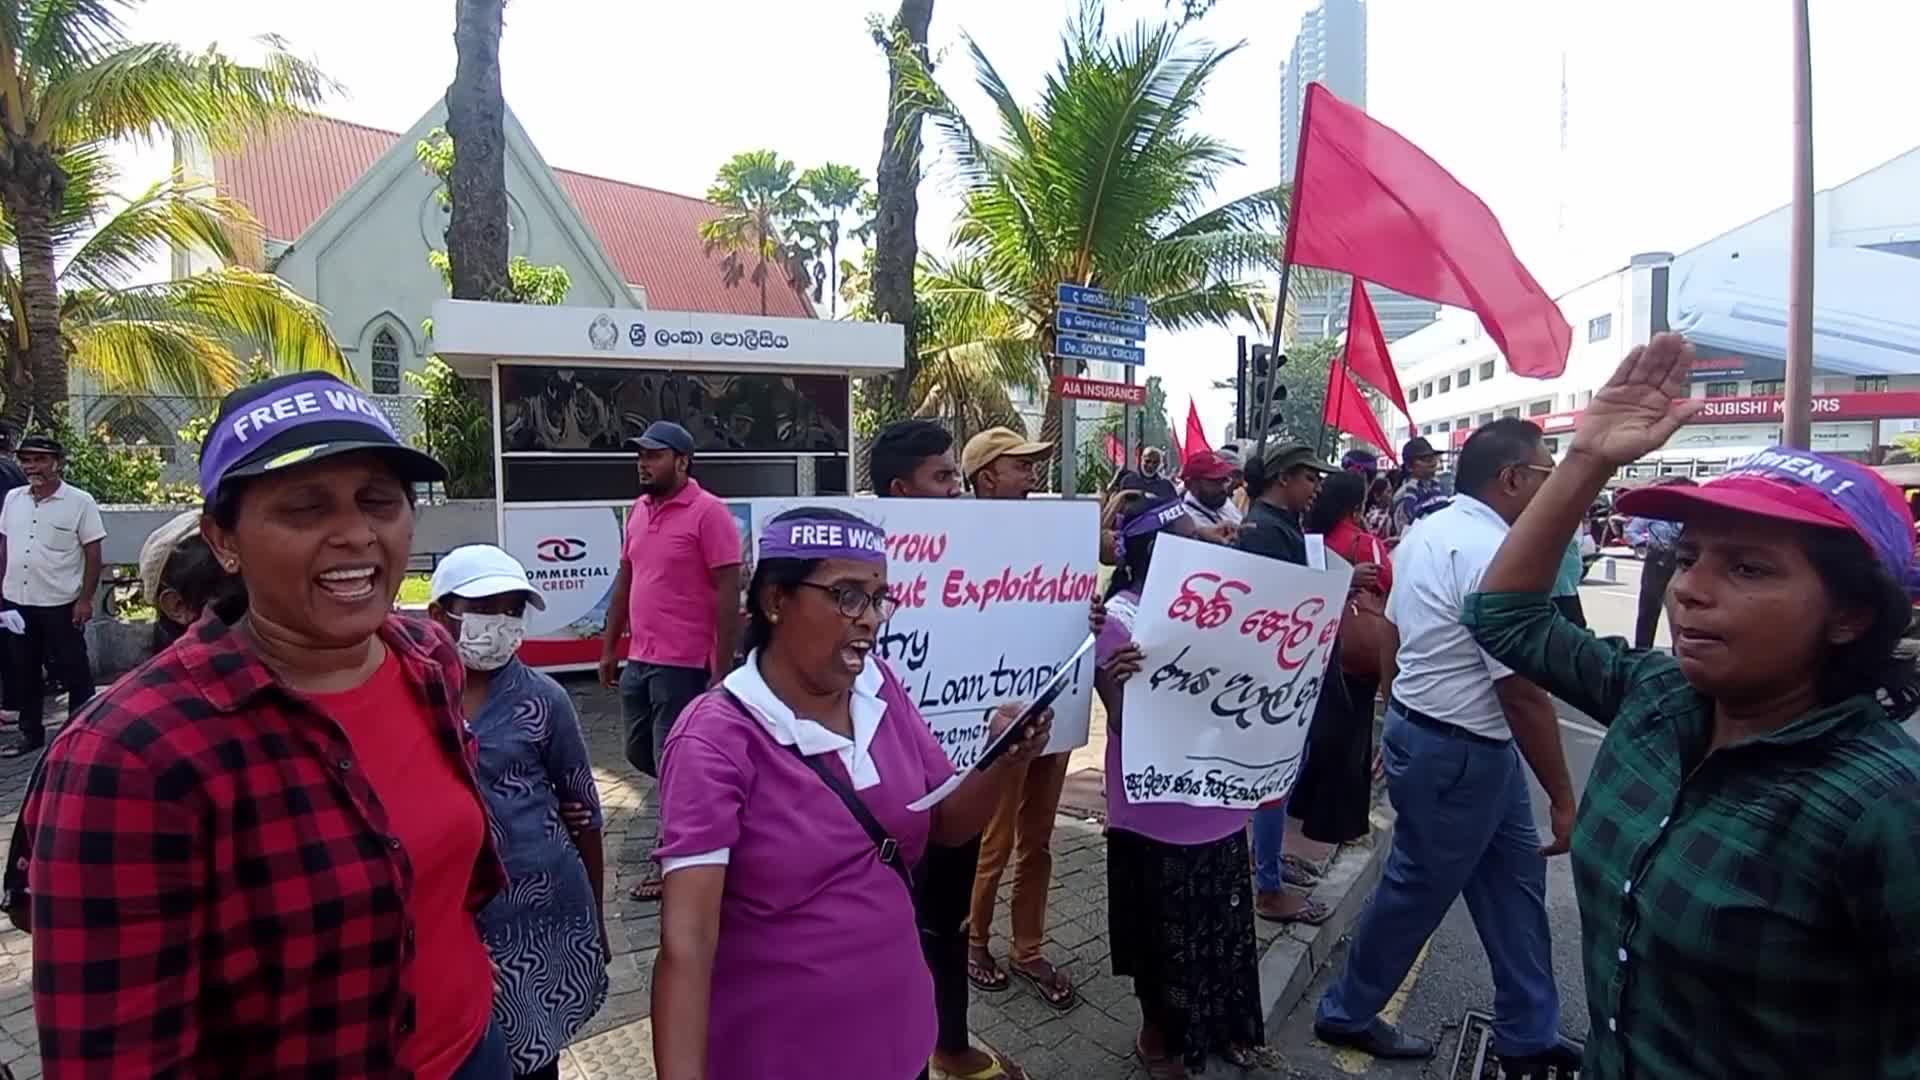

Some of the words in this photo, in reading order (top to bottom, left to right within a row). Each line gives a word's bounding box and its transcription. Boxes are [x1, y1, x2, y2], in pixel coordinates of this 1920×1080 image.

[654, 328, 704, 347] ලංකා
[1081, 343, 1109, 357] SOYSA
[1062, 381, 1081, 394] AIA
[1083, 383, 1141, 400] INSURANCE
[232, 391, 321, 442] FREE
[1702, 401, 1767, 416] SUBISHI
[1158, 501, 1184, 522] FREE
[790, 524, 843, 547] FREE
[525, 567, 609, 580] OMMERCIAL
[542, 579, 585, 592] CREDIT
[942, 562, 1098, 613] Exploitation
[877, 620, 929, 672] try
